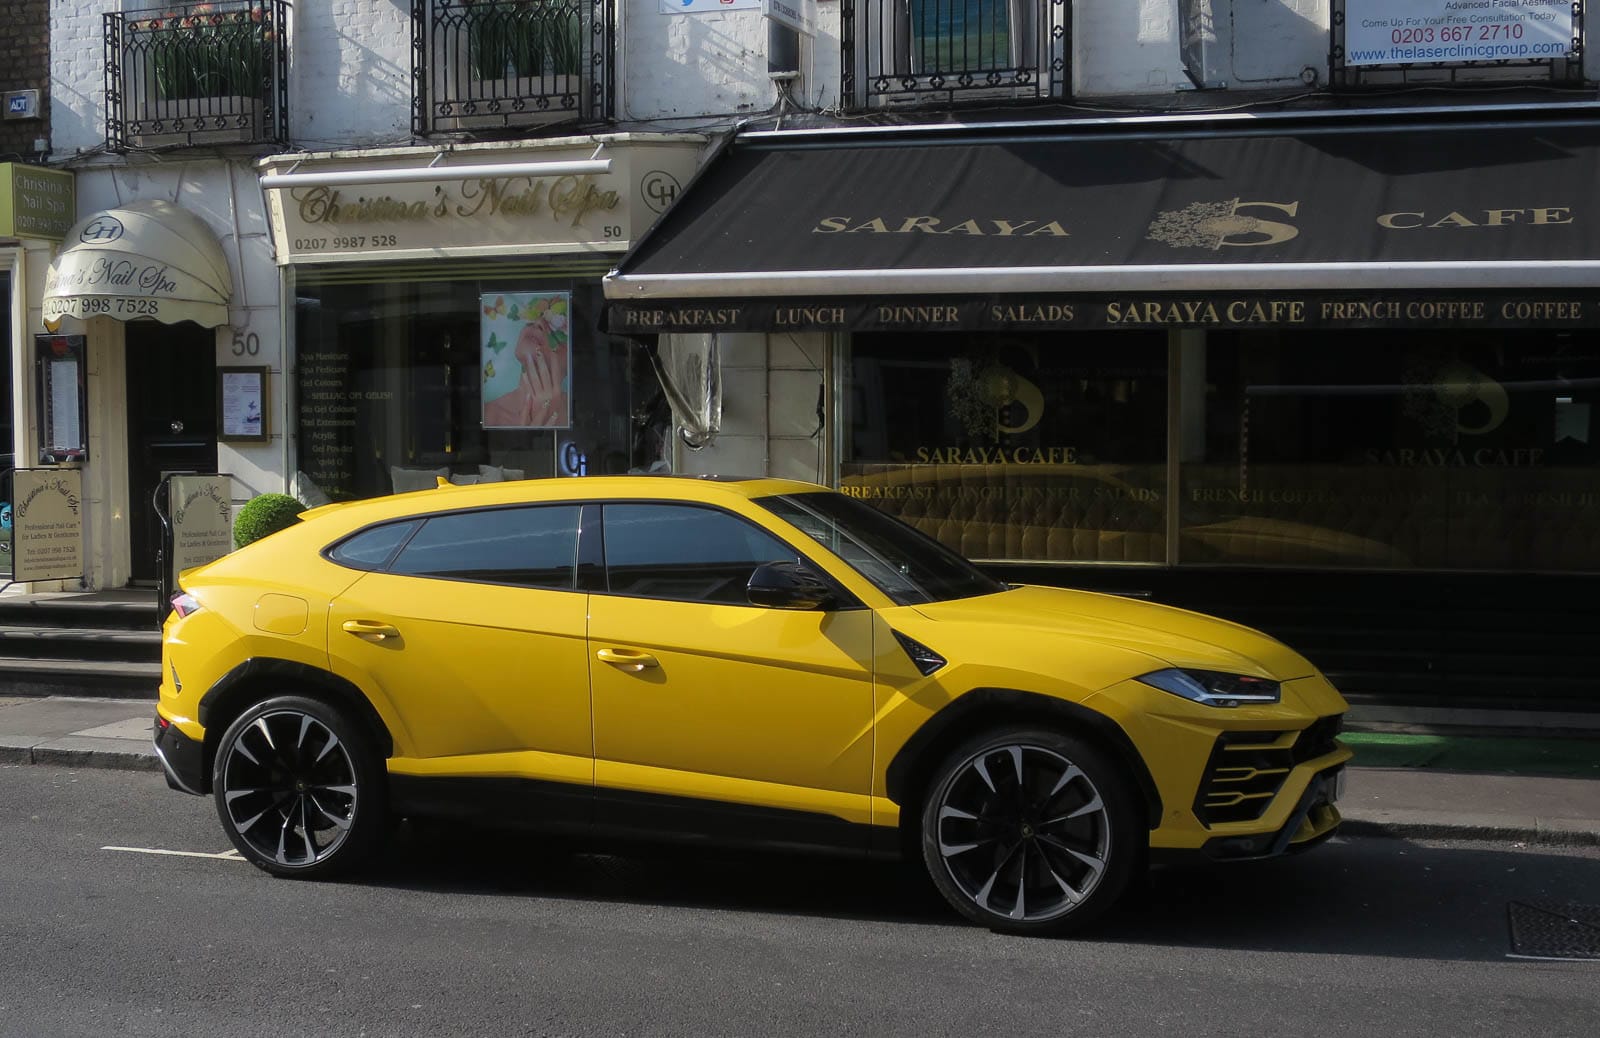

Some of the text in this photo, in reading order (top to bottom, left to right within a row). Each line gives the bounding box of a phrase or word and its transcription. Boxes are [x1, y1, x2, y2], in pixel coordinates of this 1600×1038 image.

[1445, 0, 1490, 10] Advanced
[1492, 0, 1519, 8] Facial
[1361, 11, 1556, 29] Come Up For Your Free Consultation Today
[1391, 24, 1523, 44] 0203 667 2710
[1350, 41, 1565, 61] www.thelaserclinicgroup.com
[11, 99, 26, 110] ADT
[457, 176, 544, 217] Nail
[548, 174, 620, 227] Spa
[811, 216, 1072, 236] SARAYA
[1376, 207, 1575, 229] CAFE
[603, 226, 622, 238] 50
[295, 235, 397, 250] 0207 9987 528
[88, 258, 137, 285] Nail
[138, 266, 177, 295] Spa
[51, 299, 77, 314] 0207
[82, 298, 111, 313] 998
[116, 299, 159, 315] 7528
[625, 301, 1582, 325] BREAKFAST LUNCH DINNER SALADS SARAYA CAFE FRENCH COFFEE COFFEE
[231, 332, 260, 356] 50
[916, 446, 1078, 466] SARAYA CAFE
[1363, 447, 1468, 467] SARAYA
[841, 485, 1160, 501] BREAKFAST LUNCH DINNER SALADS
